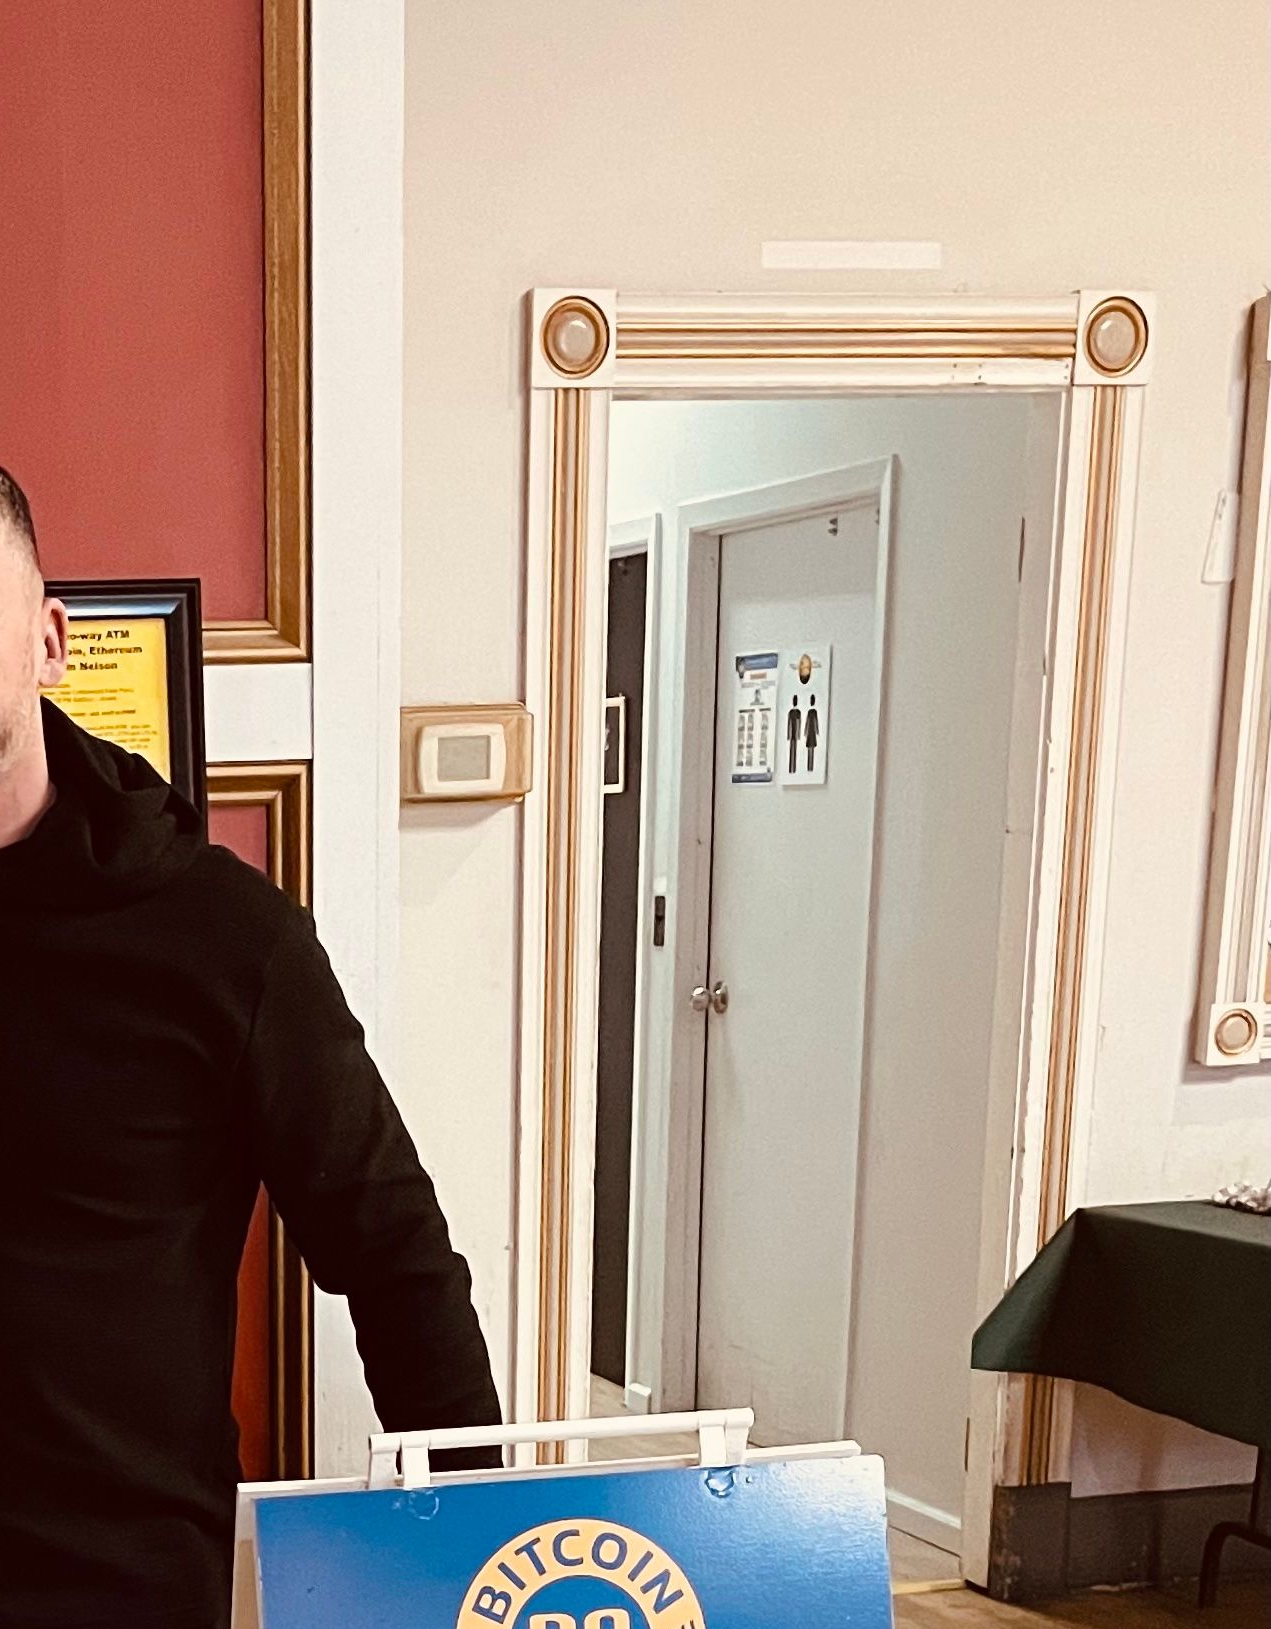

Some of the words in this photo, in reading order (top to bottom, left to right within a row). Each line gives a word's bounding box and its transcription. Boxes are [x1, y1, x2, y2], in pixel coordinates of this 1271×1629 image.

[67, 632, 102, 642] o-way
[106, 630, 130, 639] ATM
[89, 646, 142, 655] Ethereum
[80, 661, 118, 670] Nelson
[471, 1528, 684, 1625] BITCOIN
